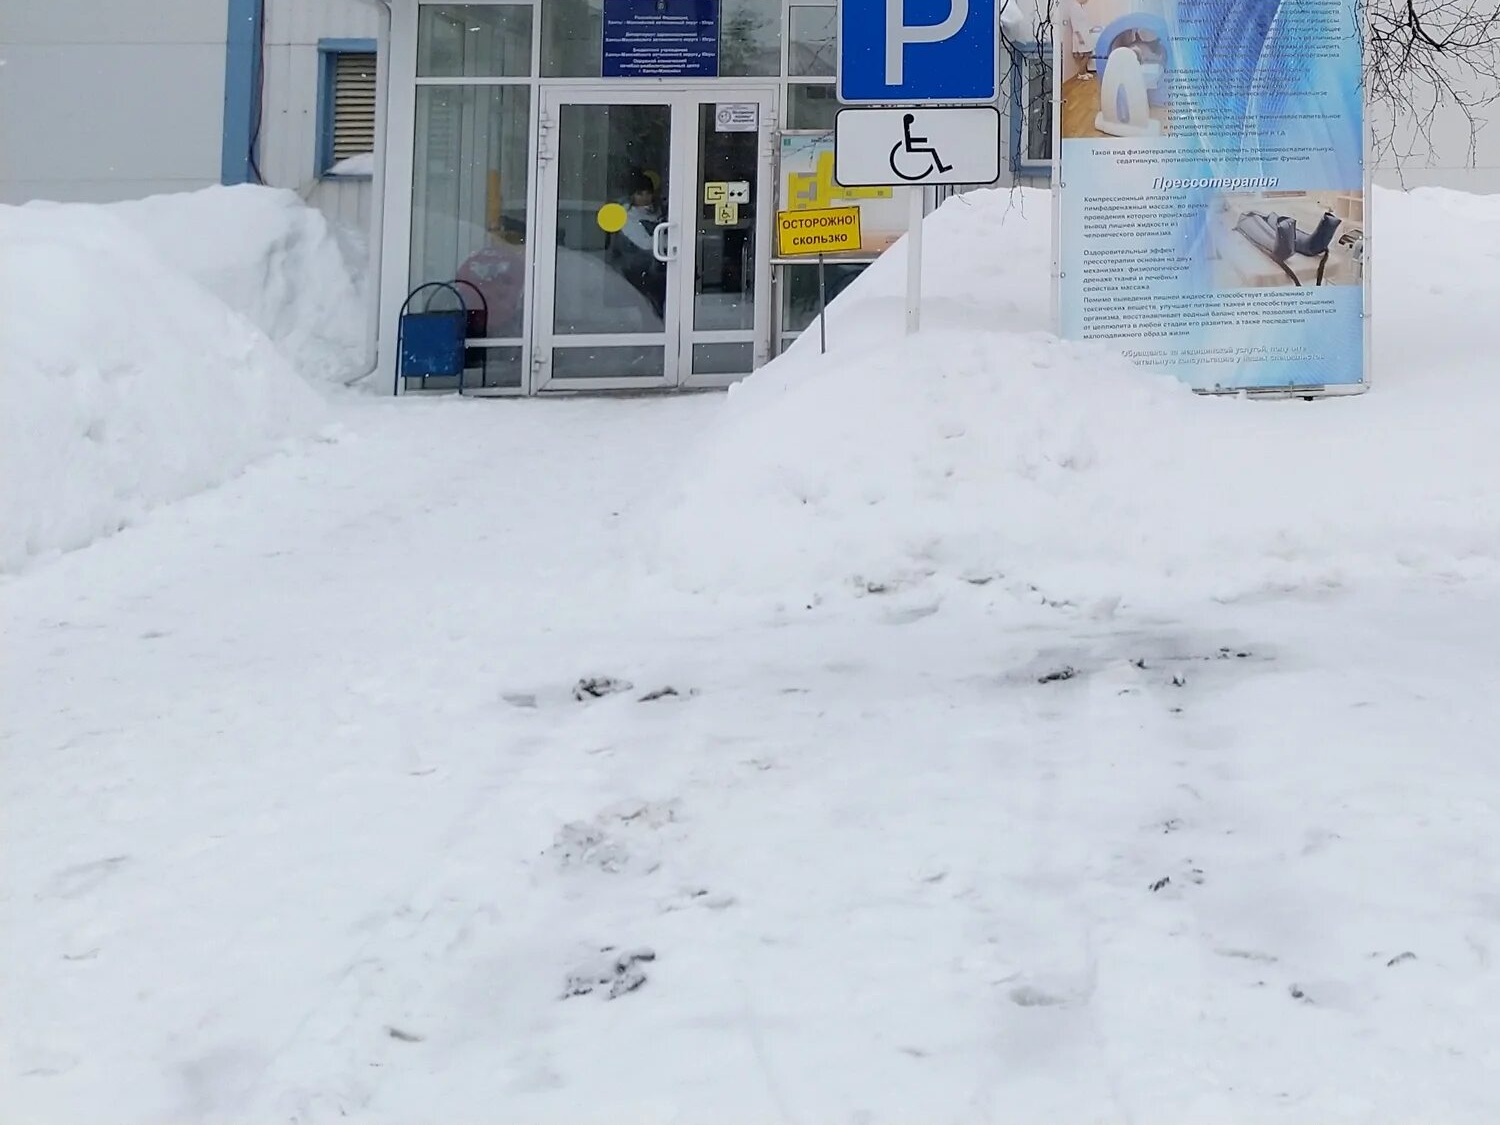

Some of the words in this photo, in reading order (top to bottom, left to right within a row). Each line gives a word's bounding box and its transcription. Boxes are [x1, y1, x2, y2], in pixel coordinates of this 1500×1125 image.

[1152, 177, 1279, 191] Прессотерапия
[782, 215, 856, 230] ОСТОРОЖНО!
[792, 233, 848, 246] СКОЛЬЗКО
